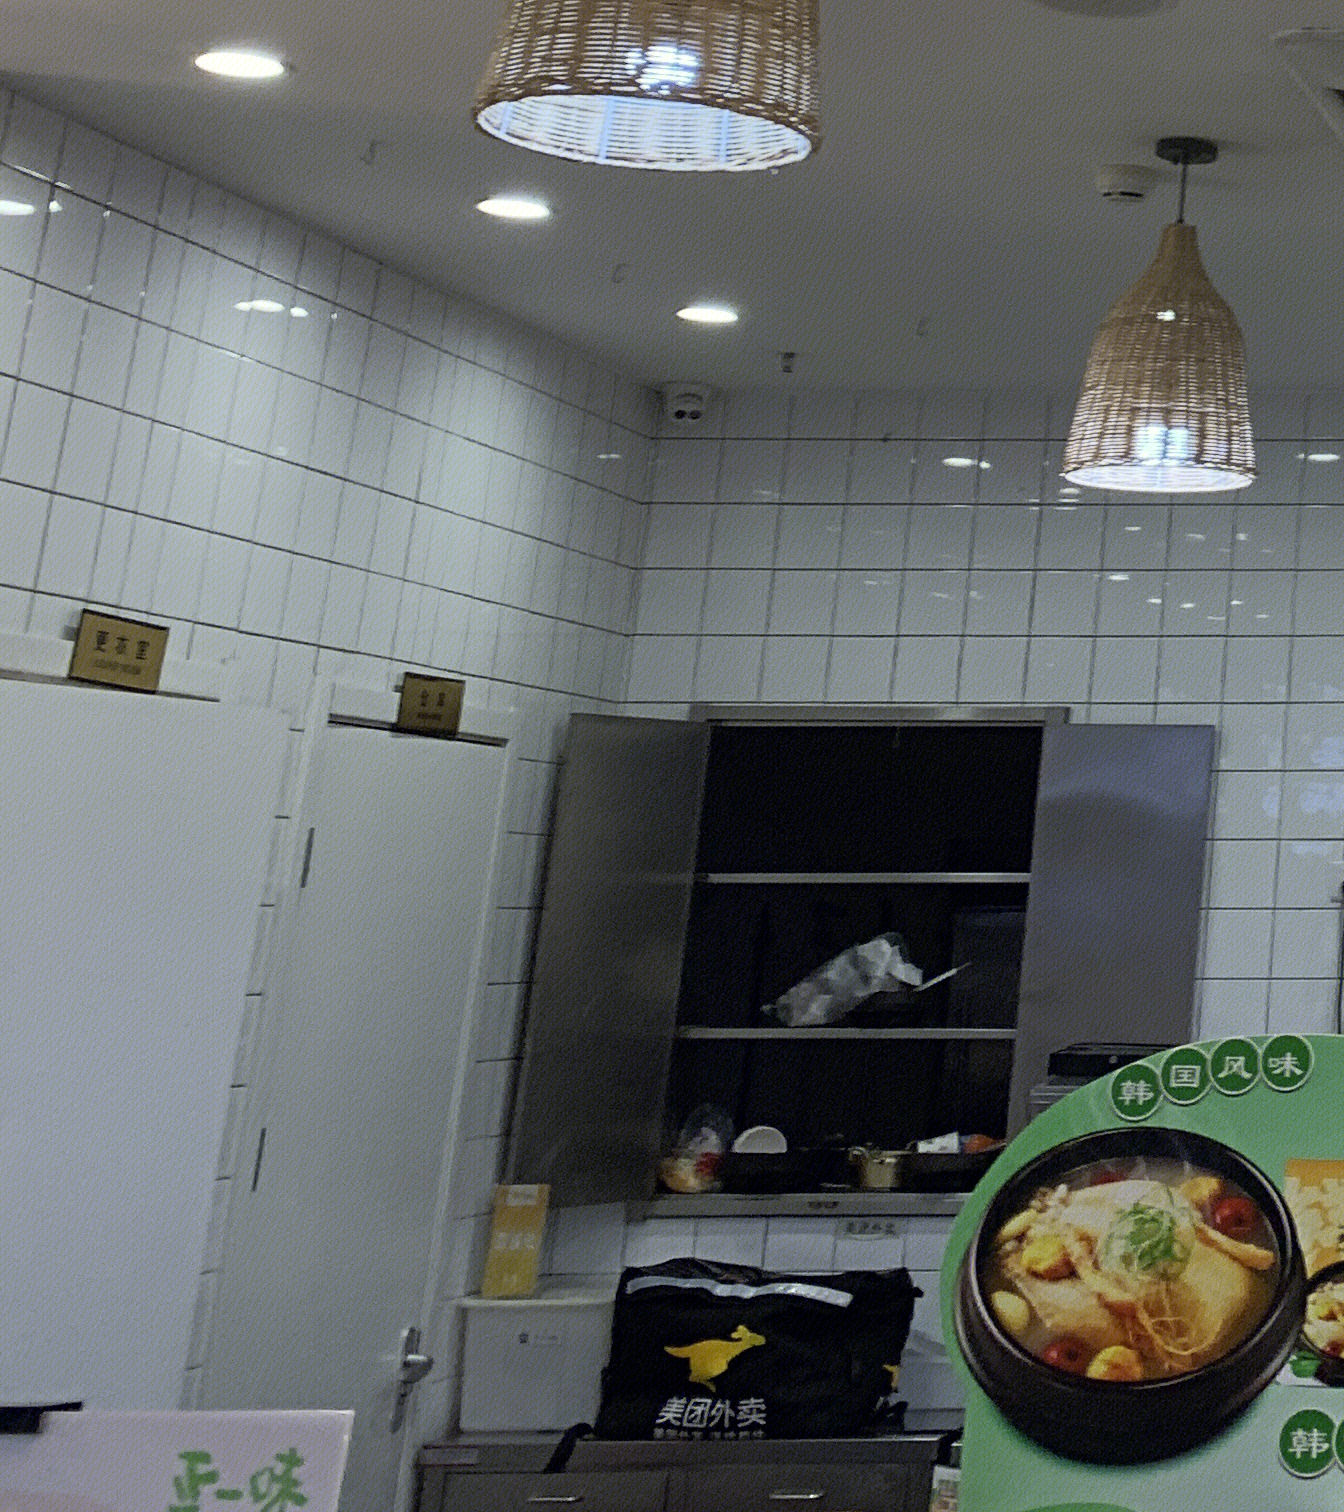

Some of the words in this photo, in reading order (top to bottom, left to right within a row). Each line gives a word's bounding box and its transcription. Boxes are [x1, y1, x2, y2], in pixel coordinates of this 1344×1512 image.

[1118, 1052, 1304, 1107] 韩国风味
[654, 1396, 768, 1428] 美团外卖
[168, 1447, 309, 1512] 正一味
